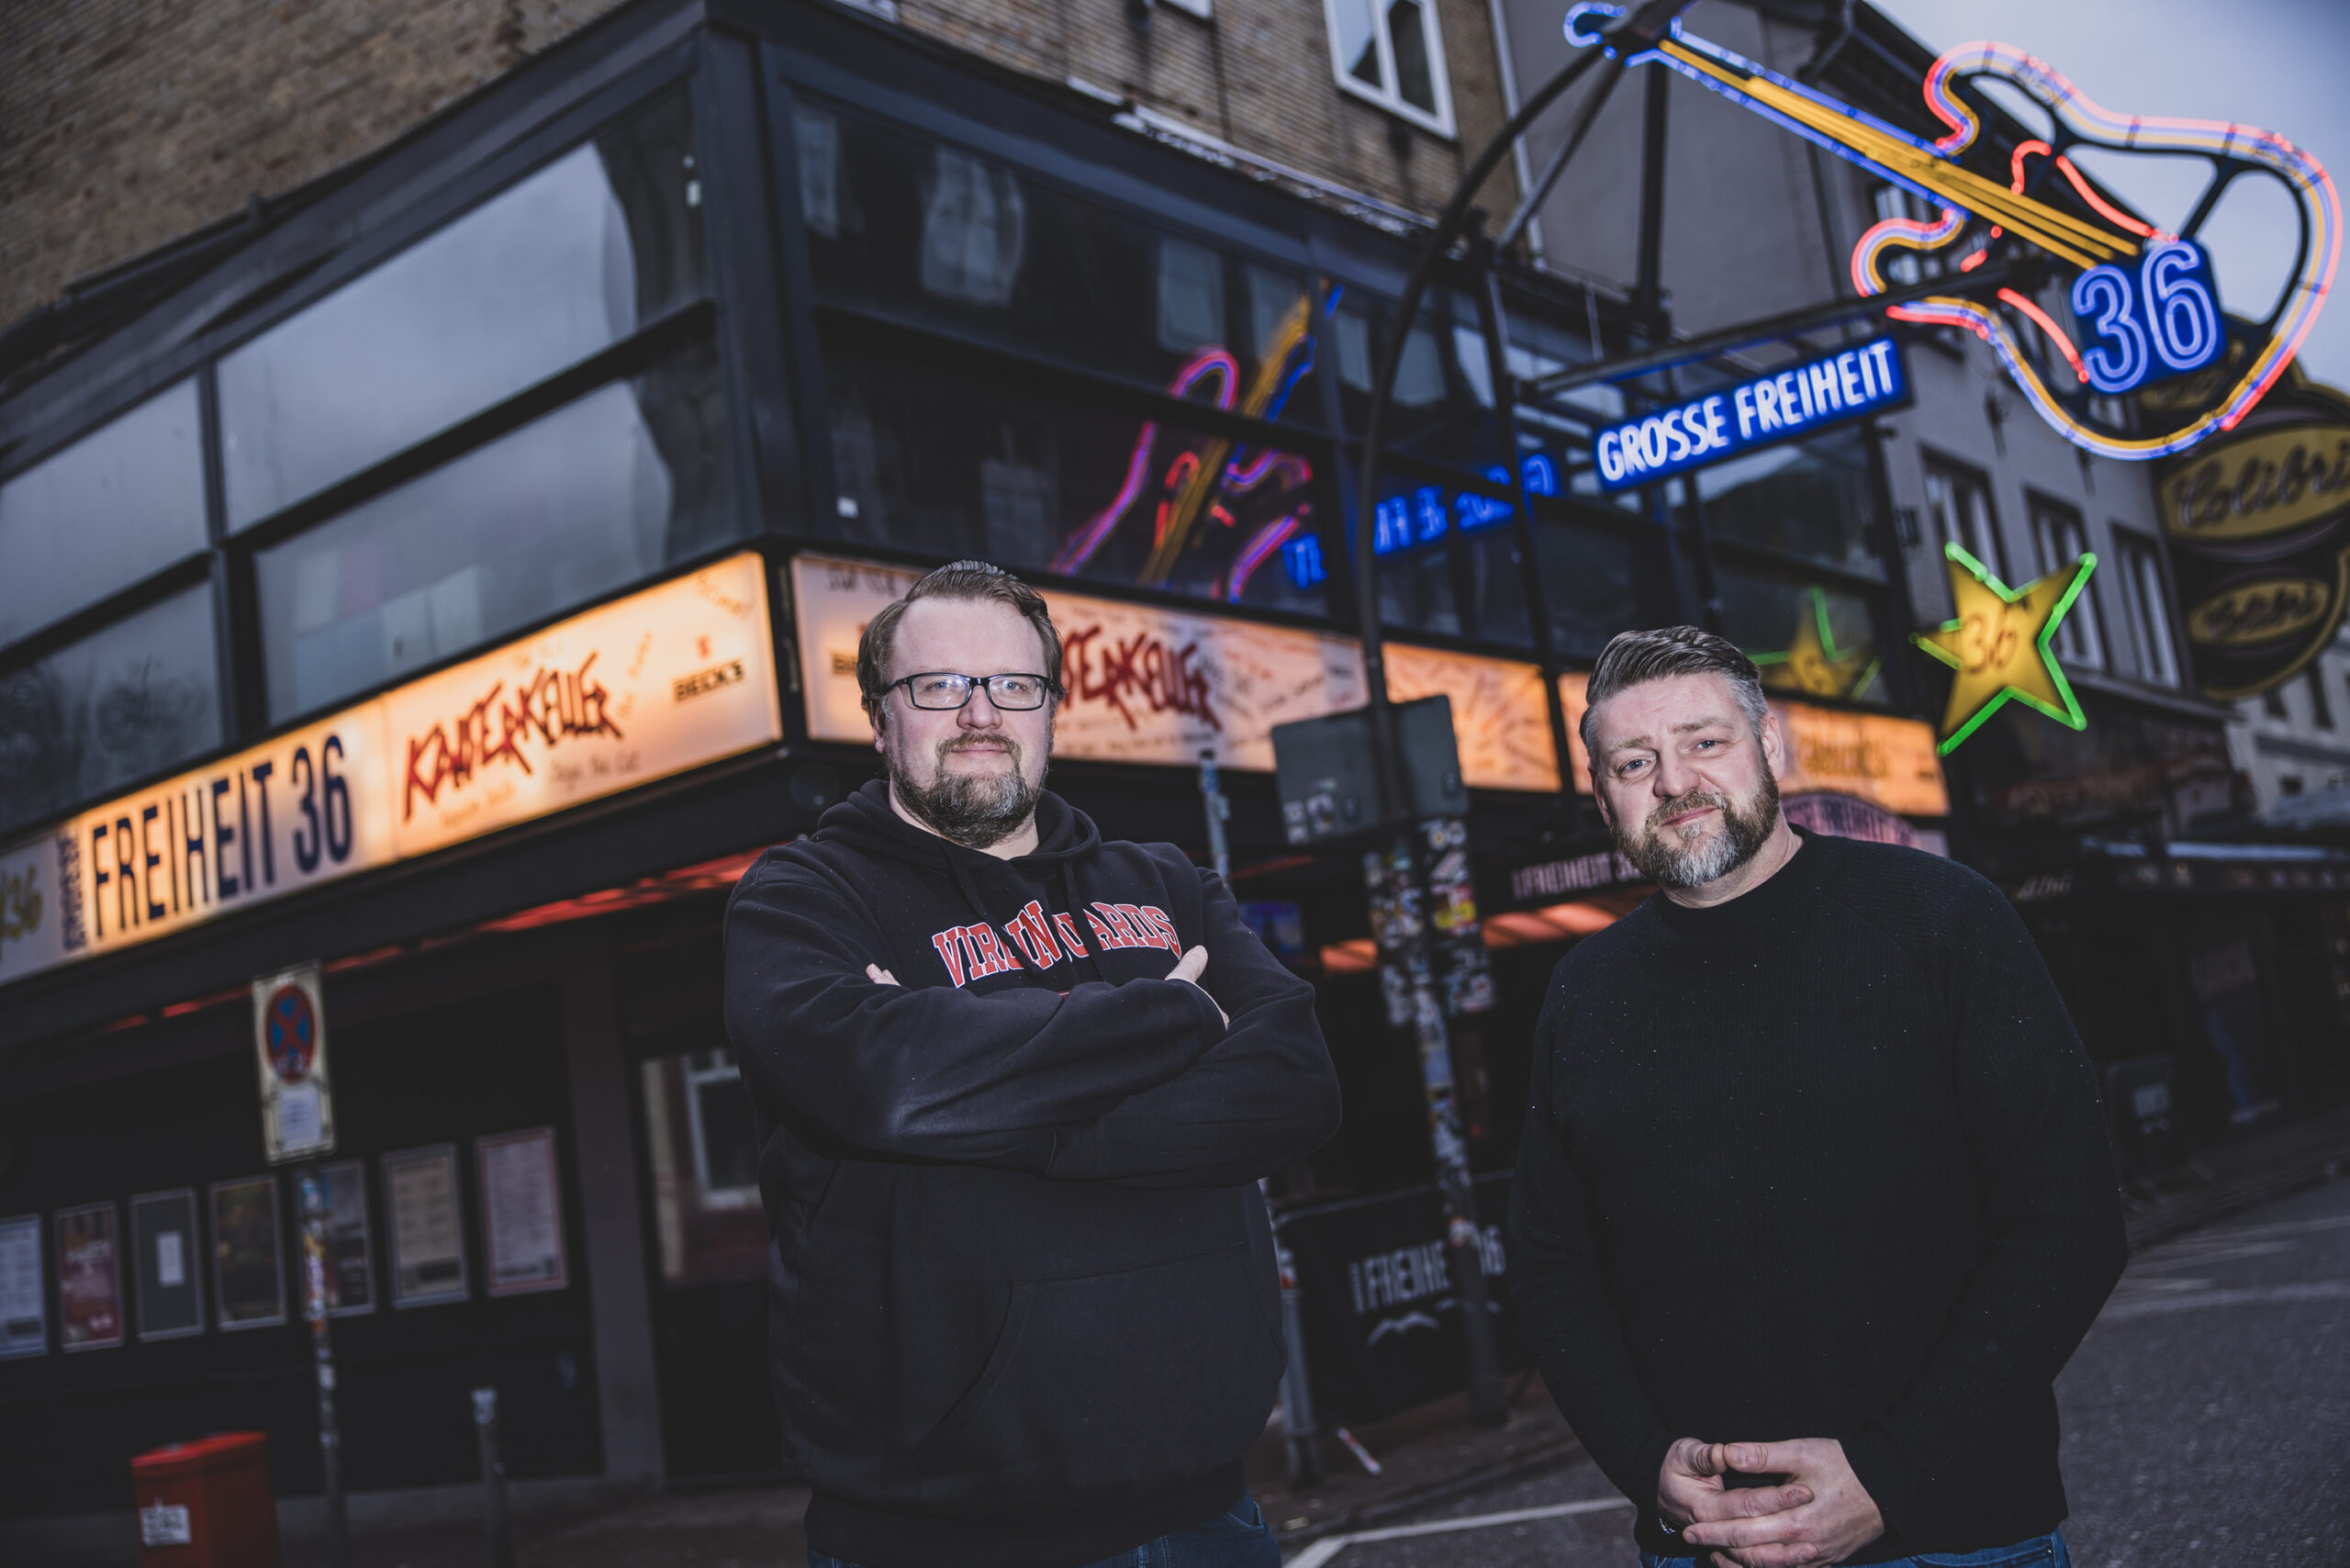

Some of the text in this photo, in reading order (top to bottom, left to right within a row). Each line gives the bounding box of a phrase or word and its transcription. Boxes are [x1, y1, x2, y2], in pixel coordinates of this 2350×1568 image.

[2071, 240, 2221, 393] 36
[1596, 339, 1896, 484] GROSSE FREIHEIT
[1962, 605, 2019, 675] 36
[93, 733, 353, 938] FREIHEIT 36
[1362, 1238, 1454, 1313] FREIHE
